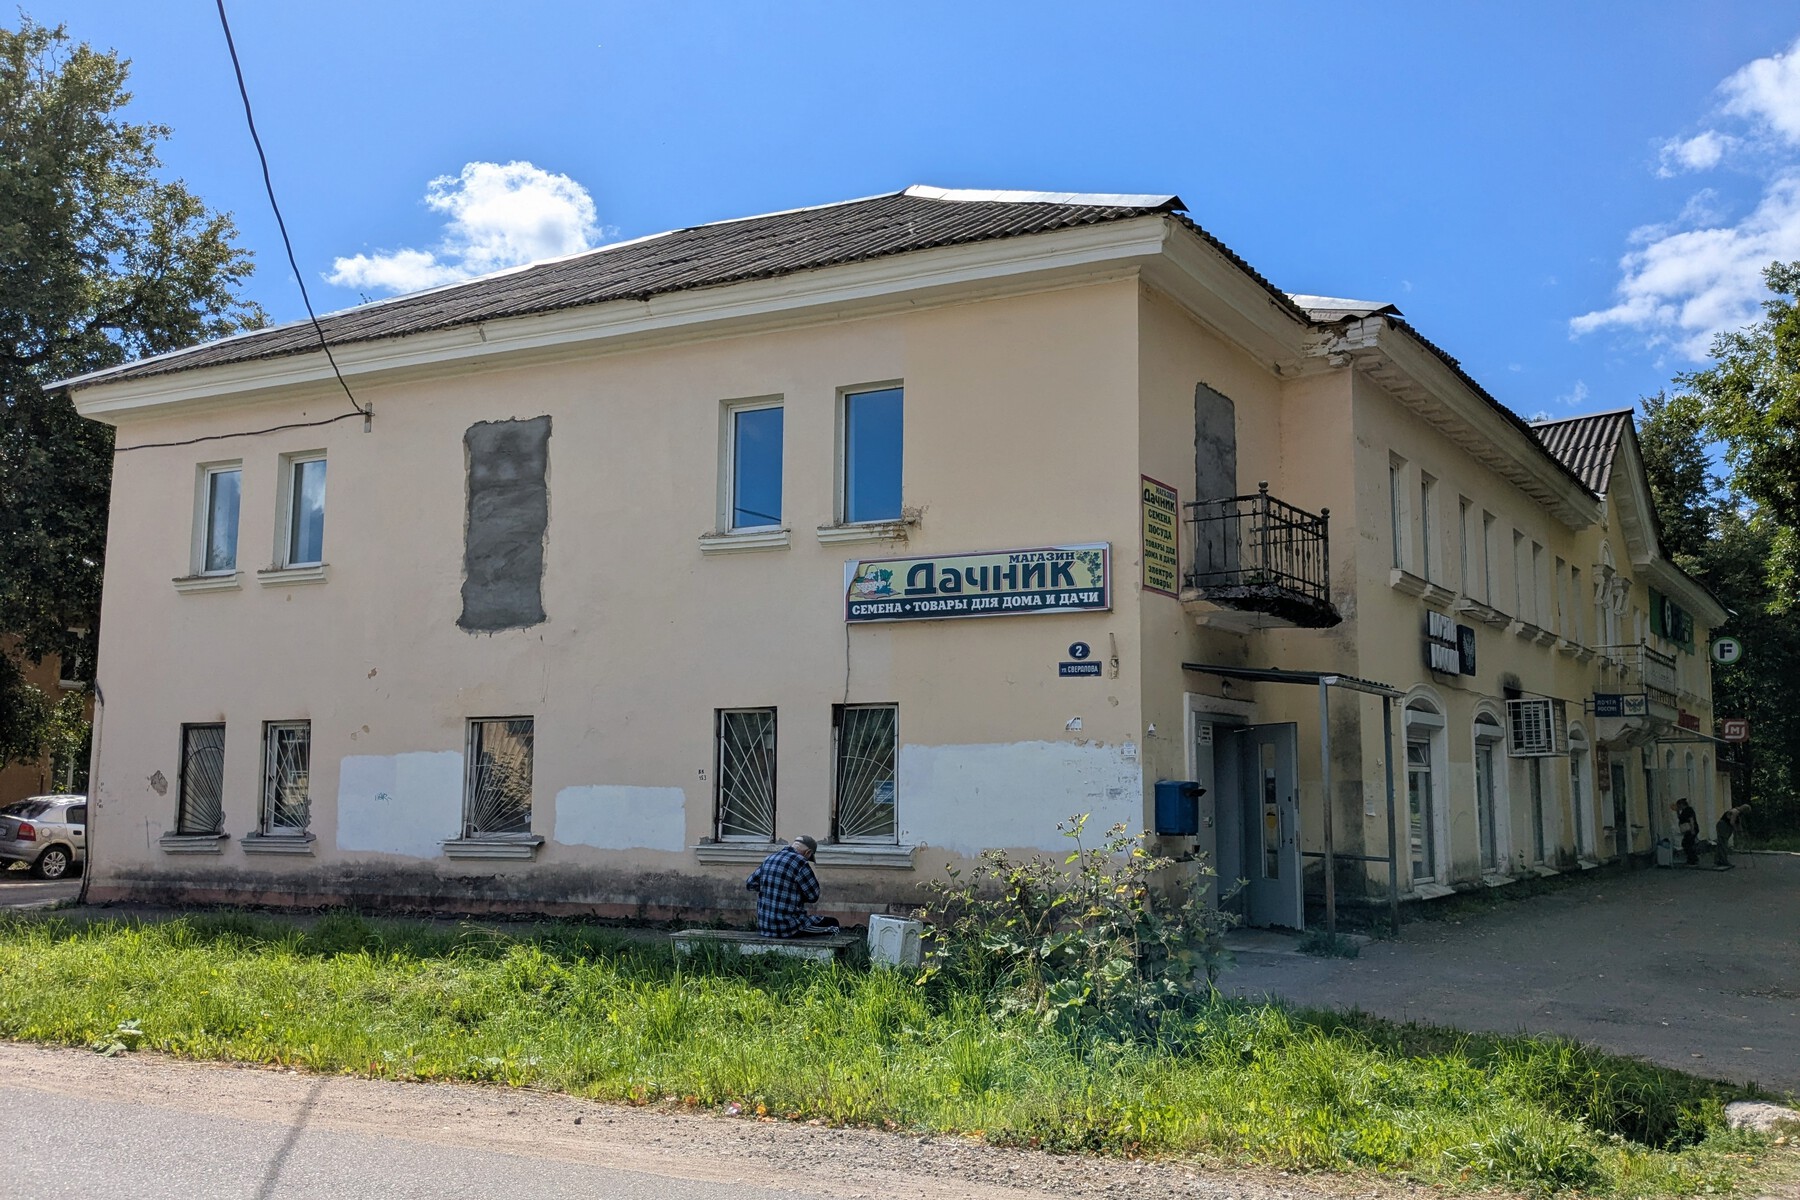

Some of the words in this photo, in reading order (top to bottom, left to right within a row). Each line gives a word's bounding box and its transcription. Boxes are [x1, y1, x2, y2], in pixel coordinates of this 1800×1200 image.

[1148, 509, 1172, 526] СЕМЕНА
[1148, 524, 1172, 540] ПОСУДА
[1145, 539, 1165, 551] ТОВАРЫ
[1166, 547, 1175, 556] ДЛЯ
[1145, 549, 1158, 560] ДОМА
[1159, 553, 1162, 561] И
[1009, 552, 1075, 564] МАГАЗИН
[852, 603, 903, 615] СЕМЕНА
[913, 599, 968, 611] ТОВАРЫ
[971, 597, 999, 610] ДЛЯ
[1002, 595, 1041, 609] ДОМА
[1046, 594, 1056, 605] И
[1059, 592, 1099, 605] ДАЧИ
[1075, 645, 1082, 656] 2
[1719, 643, 1733, 659] F
